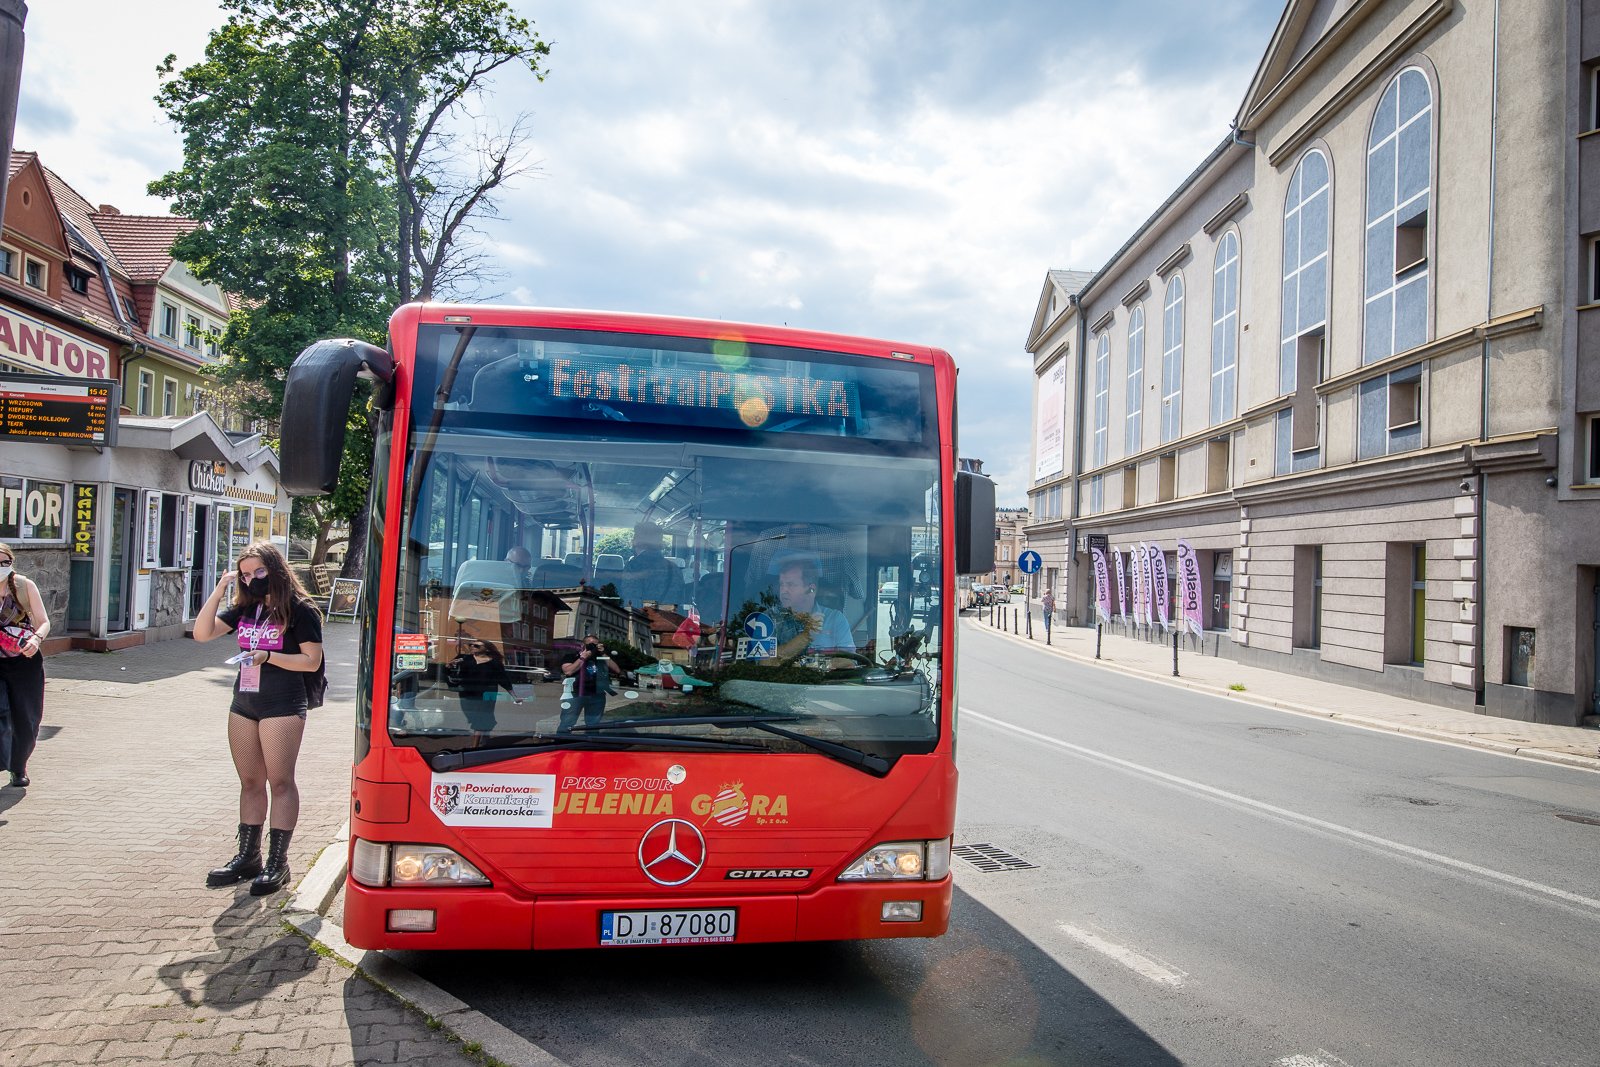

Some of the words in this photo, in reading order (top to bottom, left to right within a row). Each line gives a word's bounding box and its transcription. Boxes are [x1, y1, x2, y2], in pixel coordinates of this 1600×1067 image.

[38, 415, 71, 423] KOLEJOWY
[0, 487, 62, 527] TOR
[76, 487, 93, 554] KANTOR
[238, 625, 280, 640] peka
[465, 783, 530, 794] Powiatowa
[562, 777, 606, 790] PKS
[614, 778, 674, 791] TOUR
[464, 794, 540, 808] Komunikacja
[553, 793, 673, 815] JELENIA
[463, 805, 534, 816] Karkonoska
[728, 870, 809, 878] CITARO
[617, 914, 648, 937] DJ
[660, 913, 731, 936] 87080
